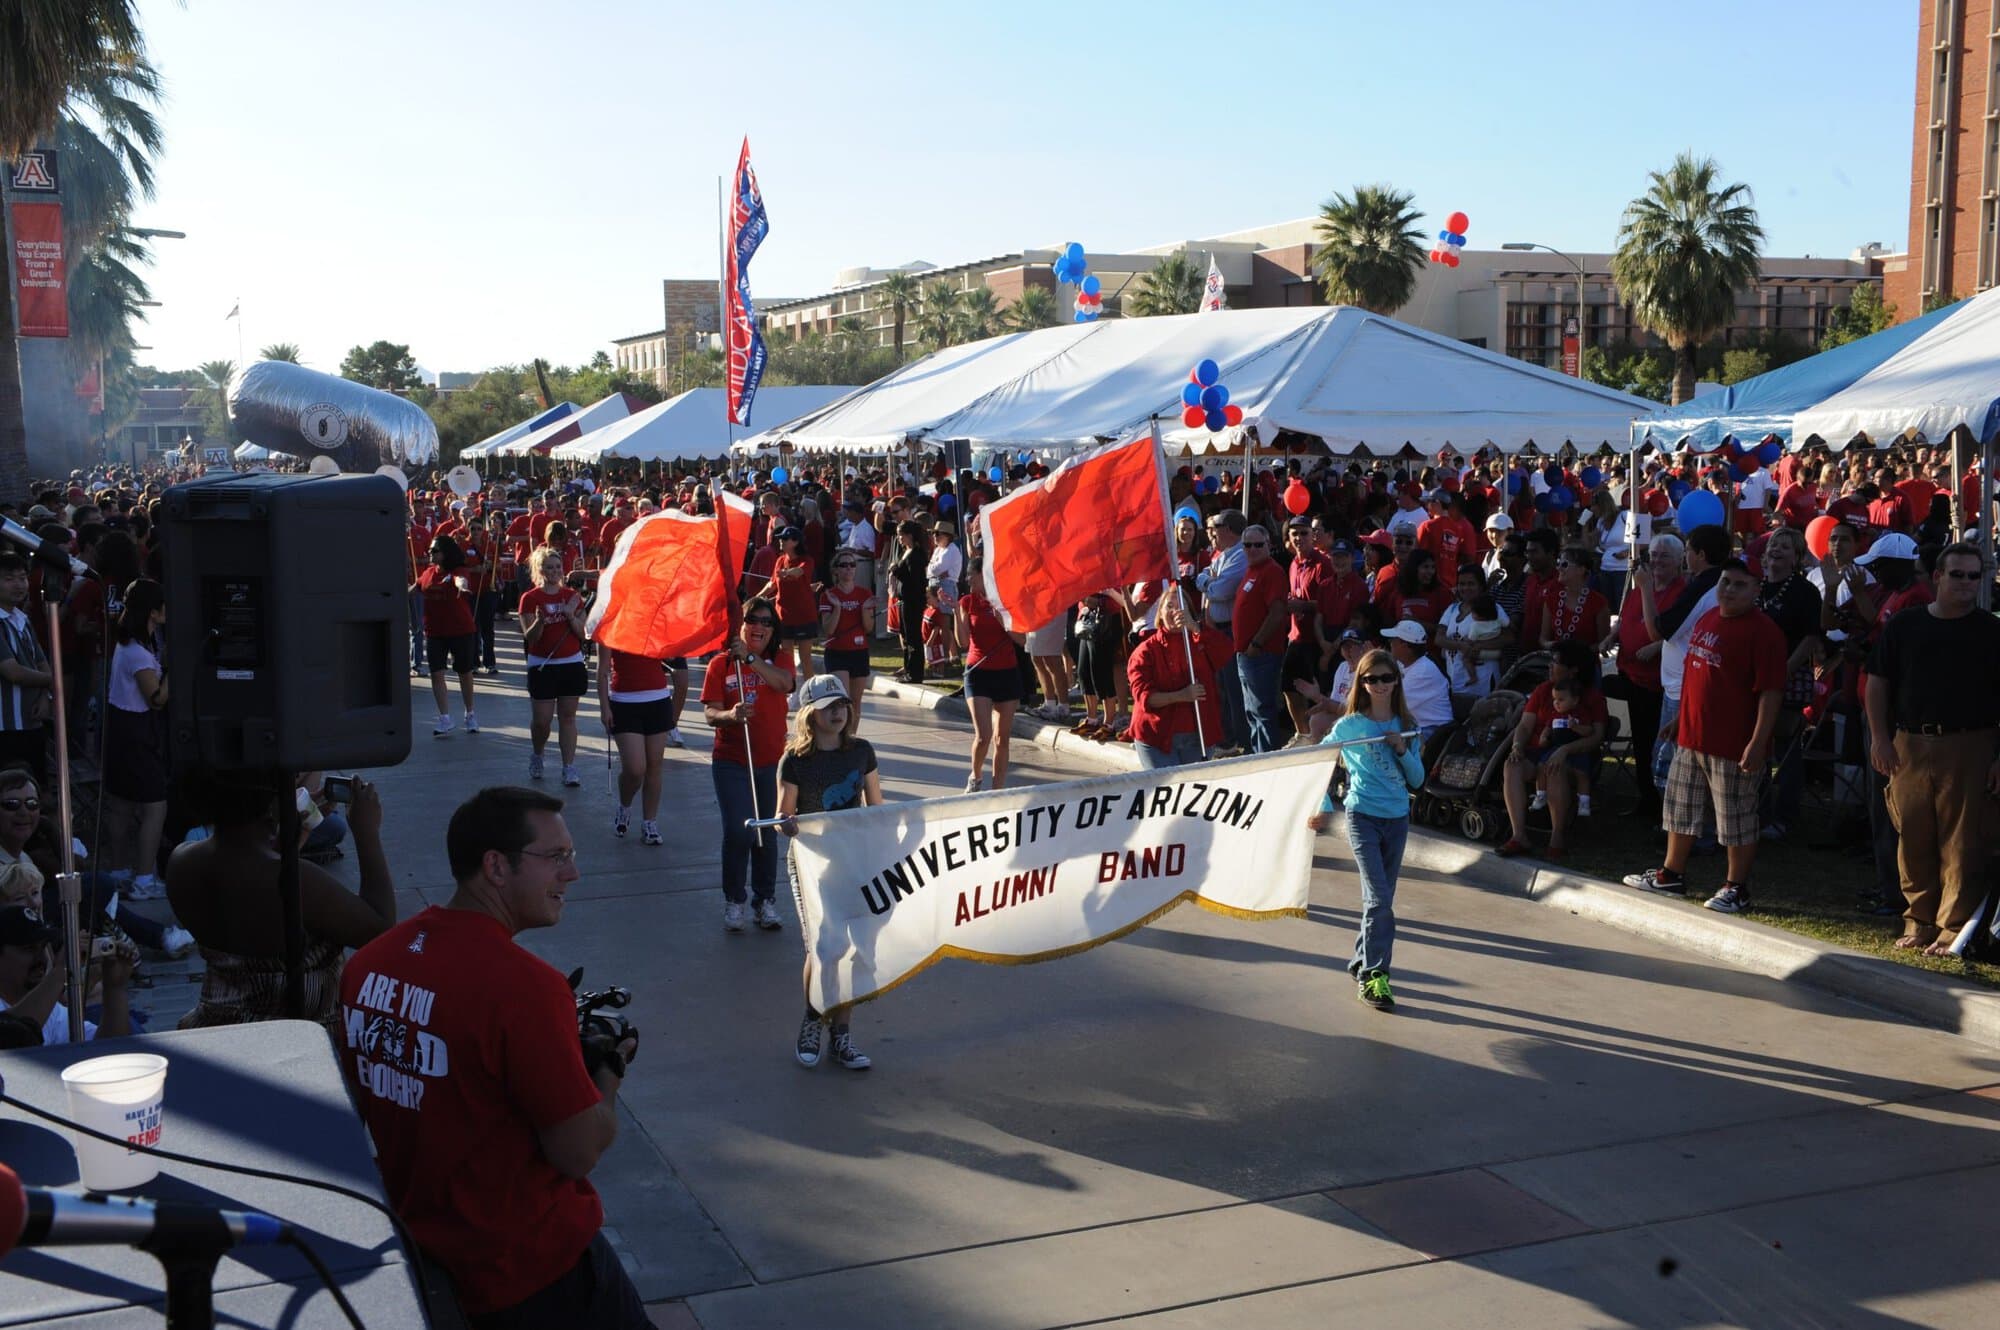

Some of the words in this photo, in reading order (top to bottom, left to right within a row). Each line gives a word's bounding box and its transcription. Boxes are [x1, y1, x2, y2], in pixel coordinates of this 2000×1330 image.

[13, 153, 55, 188] A
[17, 240, 60, 250] Everything
[17, 250, 32, 259] You
[33, 250, 62, 260] Expect
[25, 259, 47, 268] From
[30, 269, 52, 278] Great
[20, 278, 61, 289] University
[861, 803, 1066, 916] UNIVERSITY
[1075, 793, 1122, 831] OF
[1126, 782, 1264, 832] ARIZONA
[954, 862, 1058, 928] ALUMNI
[1099, 842, 1187, 885] BAND
[355, 971, 401, 1014] ARE
[399, 982, 437, 1027] YOU
[125, 1109, 145, 1121] HAVE
[138, 1113, 159, 1132] YOU
